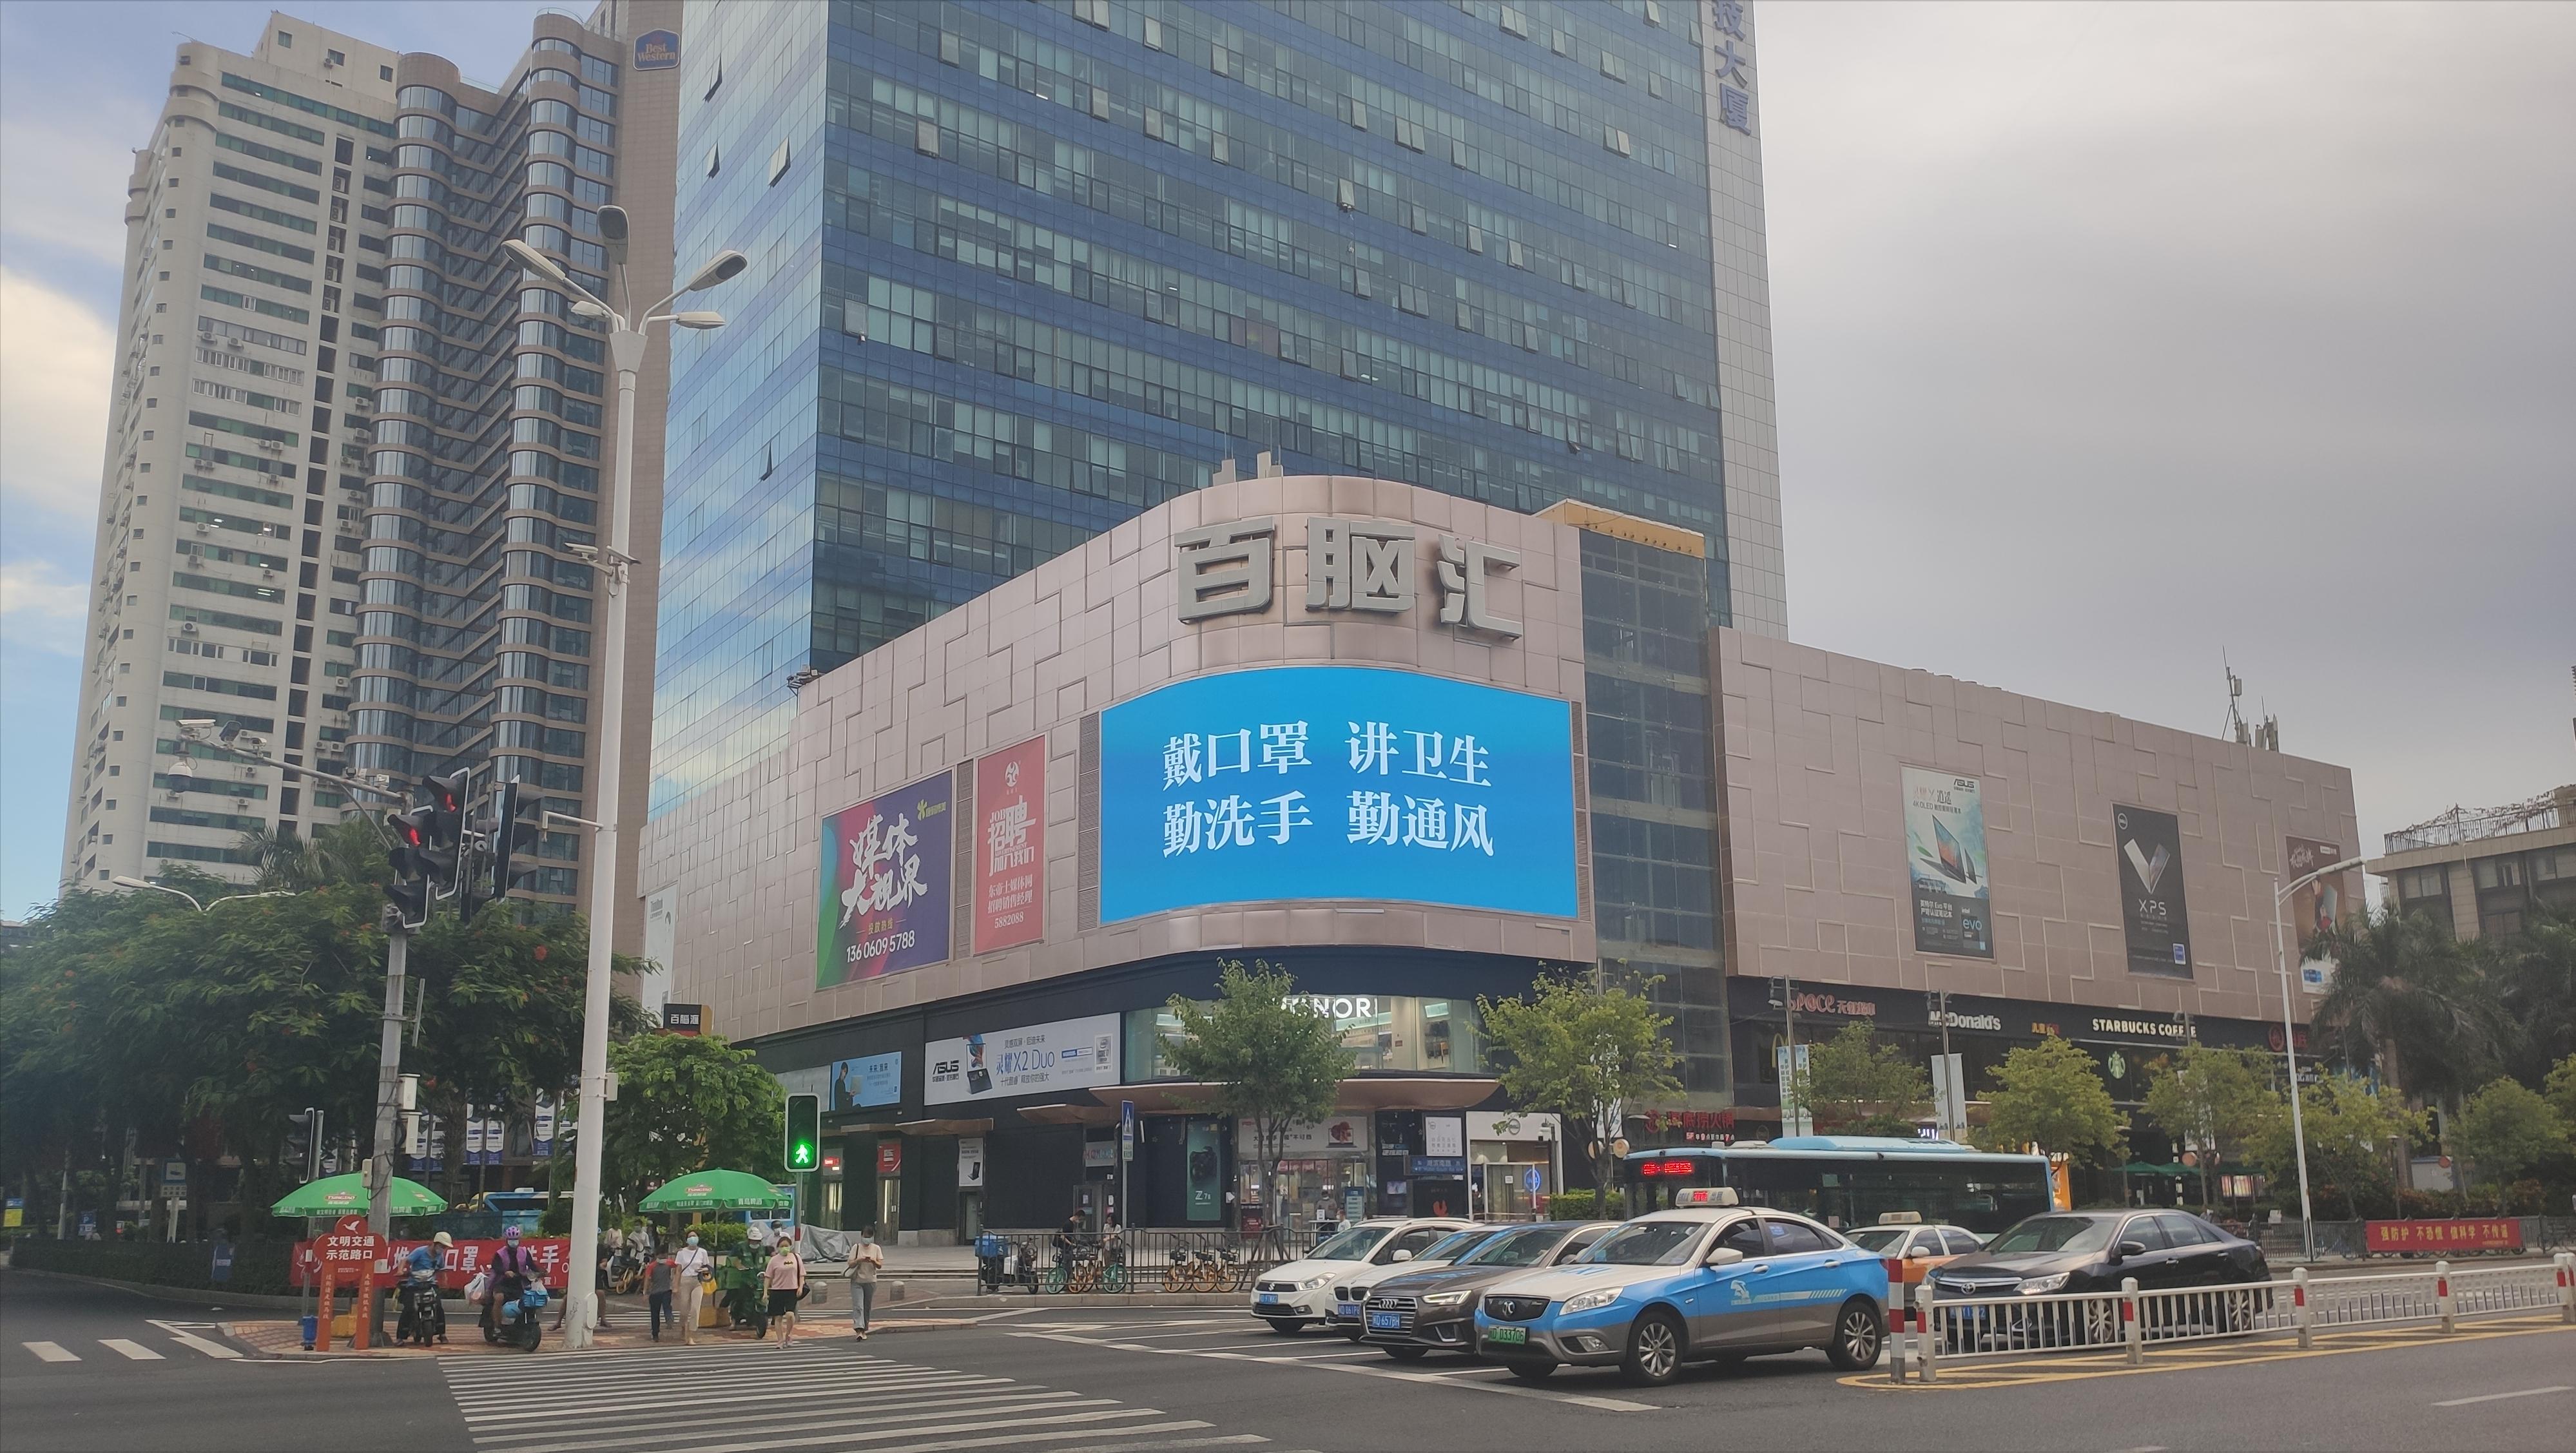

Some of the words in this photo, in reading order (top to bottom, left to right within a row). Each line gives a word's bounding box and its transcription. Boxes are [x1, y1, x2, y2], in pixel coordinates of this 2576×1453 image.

[646, 43, 667, 53] Best
[638, 52, 675, 63] Western
[1712, 0, 1751, 136] 技大厦
[1174, 517, 1522, 640] 百脑汇
[1162, 720, 1312, 791] 戴口罩
[1344, 720, 1491, 788] 讲卫生
[1953, 778, 1974, 788] ASUS
[990, 809, 1005, 823] JOB
[1162, 790, 1313, 858] 勤洗手
[1346, 790, 1494, 856] 勤通风
[987, 794, 1036, 876] 招聘
[849, 813, 918, 880] 媒体
[994, 845, 1034, 873] 加入我们
[838, 853, 927, 930] 大视界
[2139, 899, 2166, 915] XPS
[994, 911, 1023, 928] 5882088
[1963, 919, 1982, 930] evo
[847, 943, 862, 963] 136
[864, 938, 887, 958] 0609
[889, 930, 915, 952] 5788
[2093, 1019, 2156, 1035] STARBUCKS
[2158, 1023, 2196, 1038] COFFE
[933, 1060, 959, 1074] ASUS
[1032, 1049, 1054, 1069] Duo
[327, 1236, 374, 1247] 文明交通
[2380, 1226, 2409, 1241] 强防护
[2416, 1226, 2443, 1240] 不恐慌
[326, 1249, 373, 1260] 示范路口
